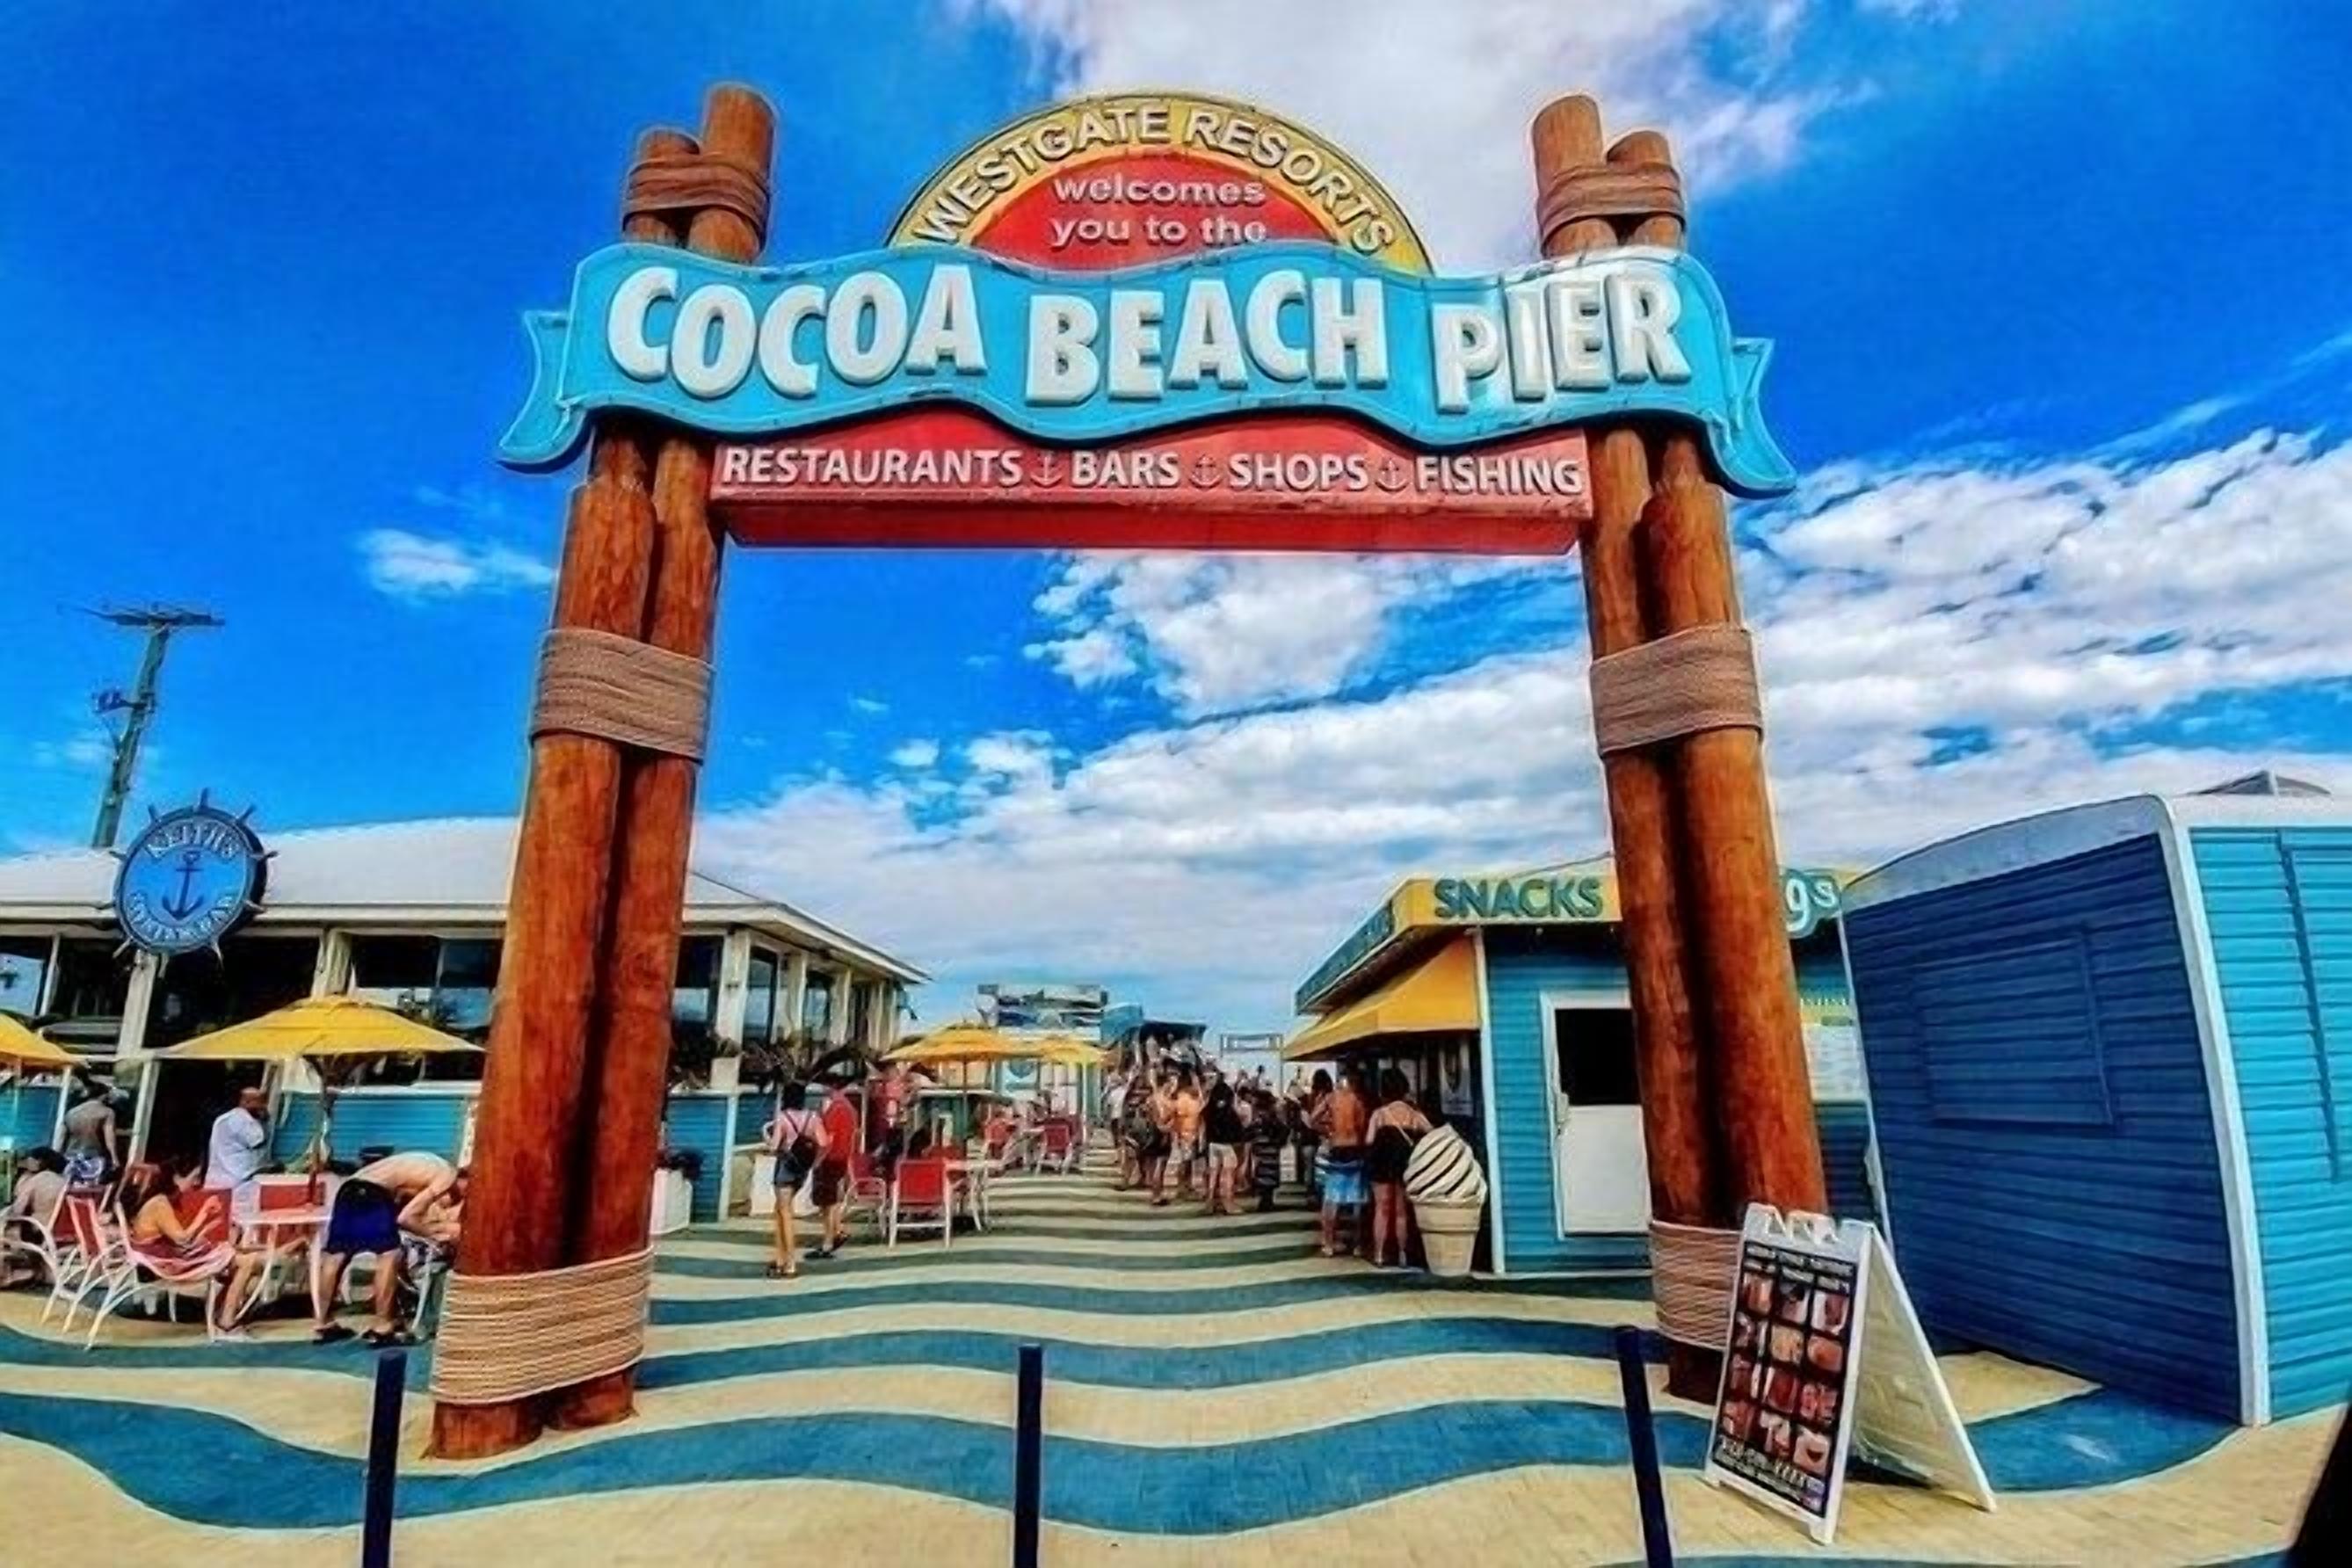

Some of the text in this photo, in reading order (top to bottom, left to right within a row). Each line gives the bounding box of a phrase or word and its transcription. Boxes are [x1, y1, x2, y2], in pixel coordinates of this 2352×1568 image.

[915, 109, 1394, 255] WESTGATE RESORTS
[1053, 173, 1267, 207] welcomes
[1050, 215, 1267, 247] you to the
[606, 265, 1692, 414] COCOA BEACH PIER
[722, 446, 1583, 496] RESTAURANTS BARS SHOPS FISHING
[1434, 877, 1604, 918] SNACKS
